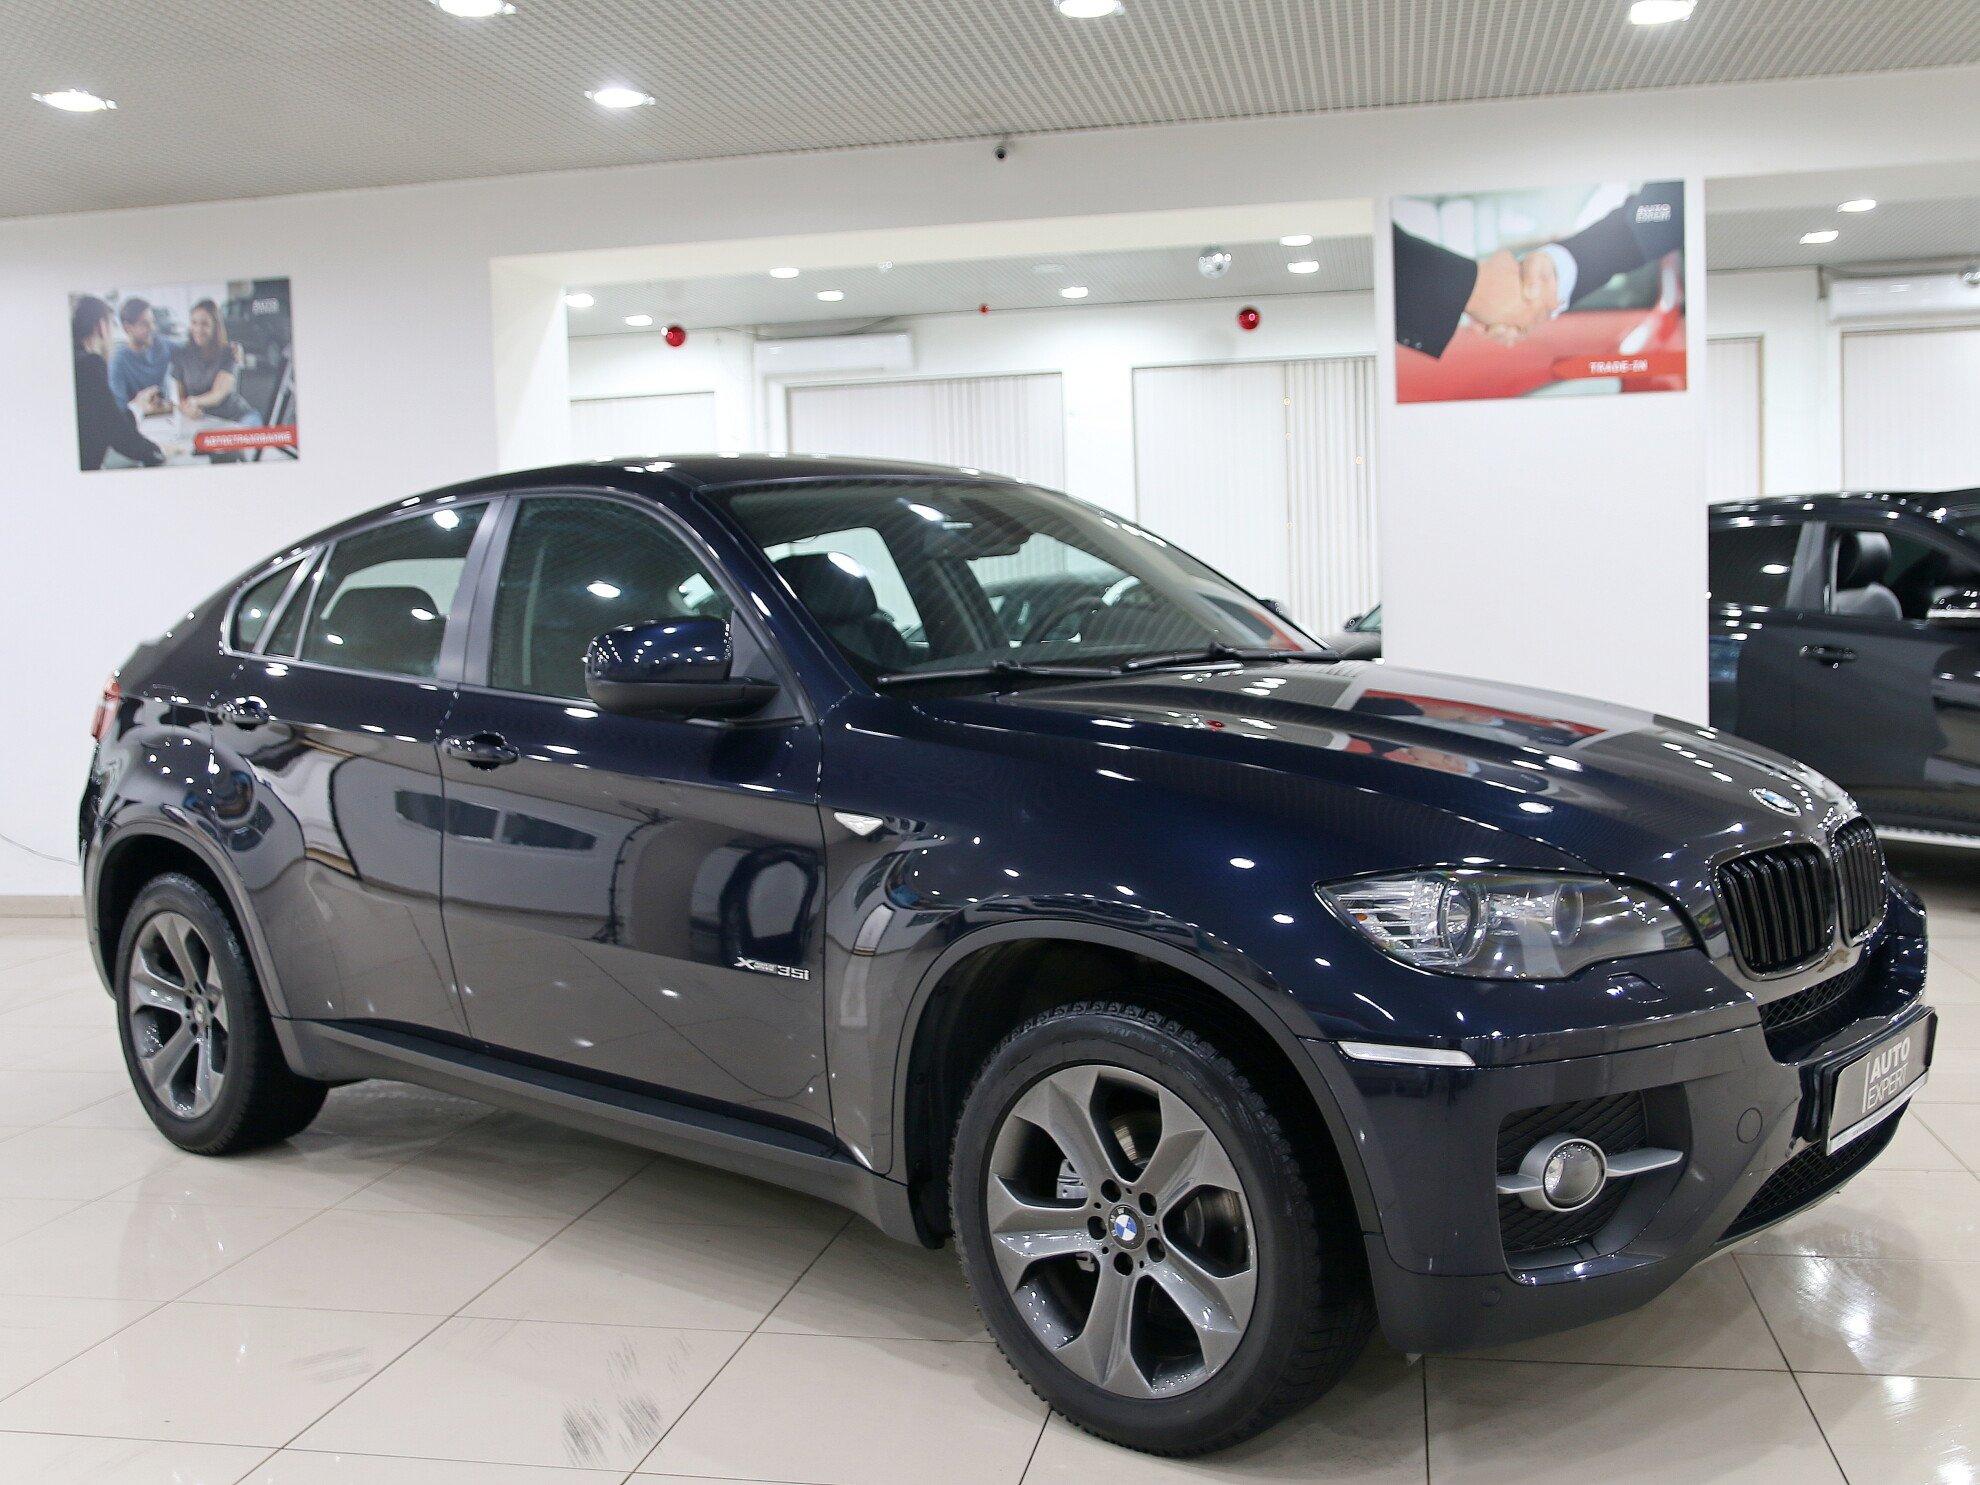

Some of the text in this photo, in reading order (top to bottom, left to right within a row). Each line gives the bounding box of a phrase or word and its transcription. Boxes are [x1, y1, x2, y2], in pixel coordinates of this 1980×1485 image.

[1589, 359, 1648, 374] TRADE-IN
[1869, 1036, 1911, 1084] AUTO
[1867, 1063, 1908, 1110] EXPERT
